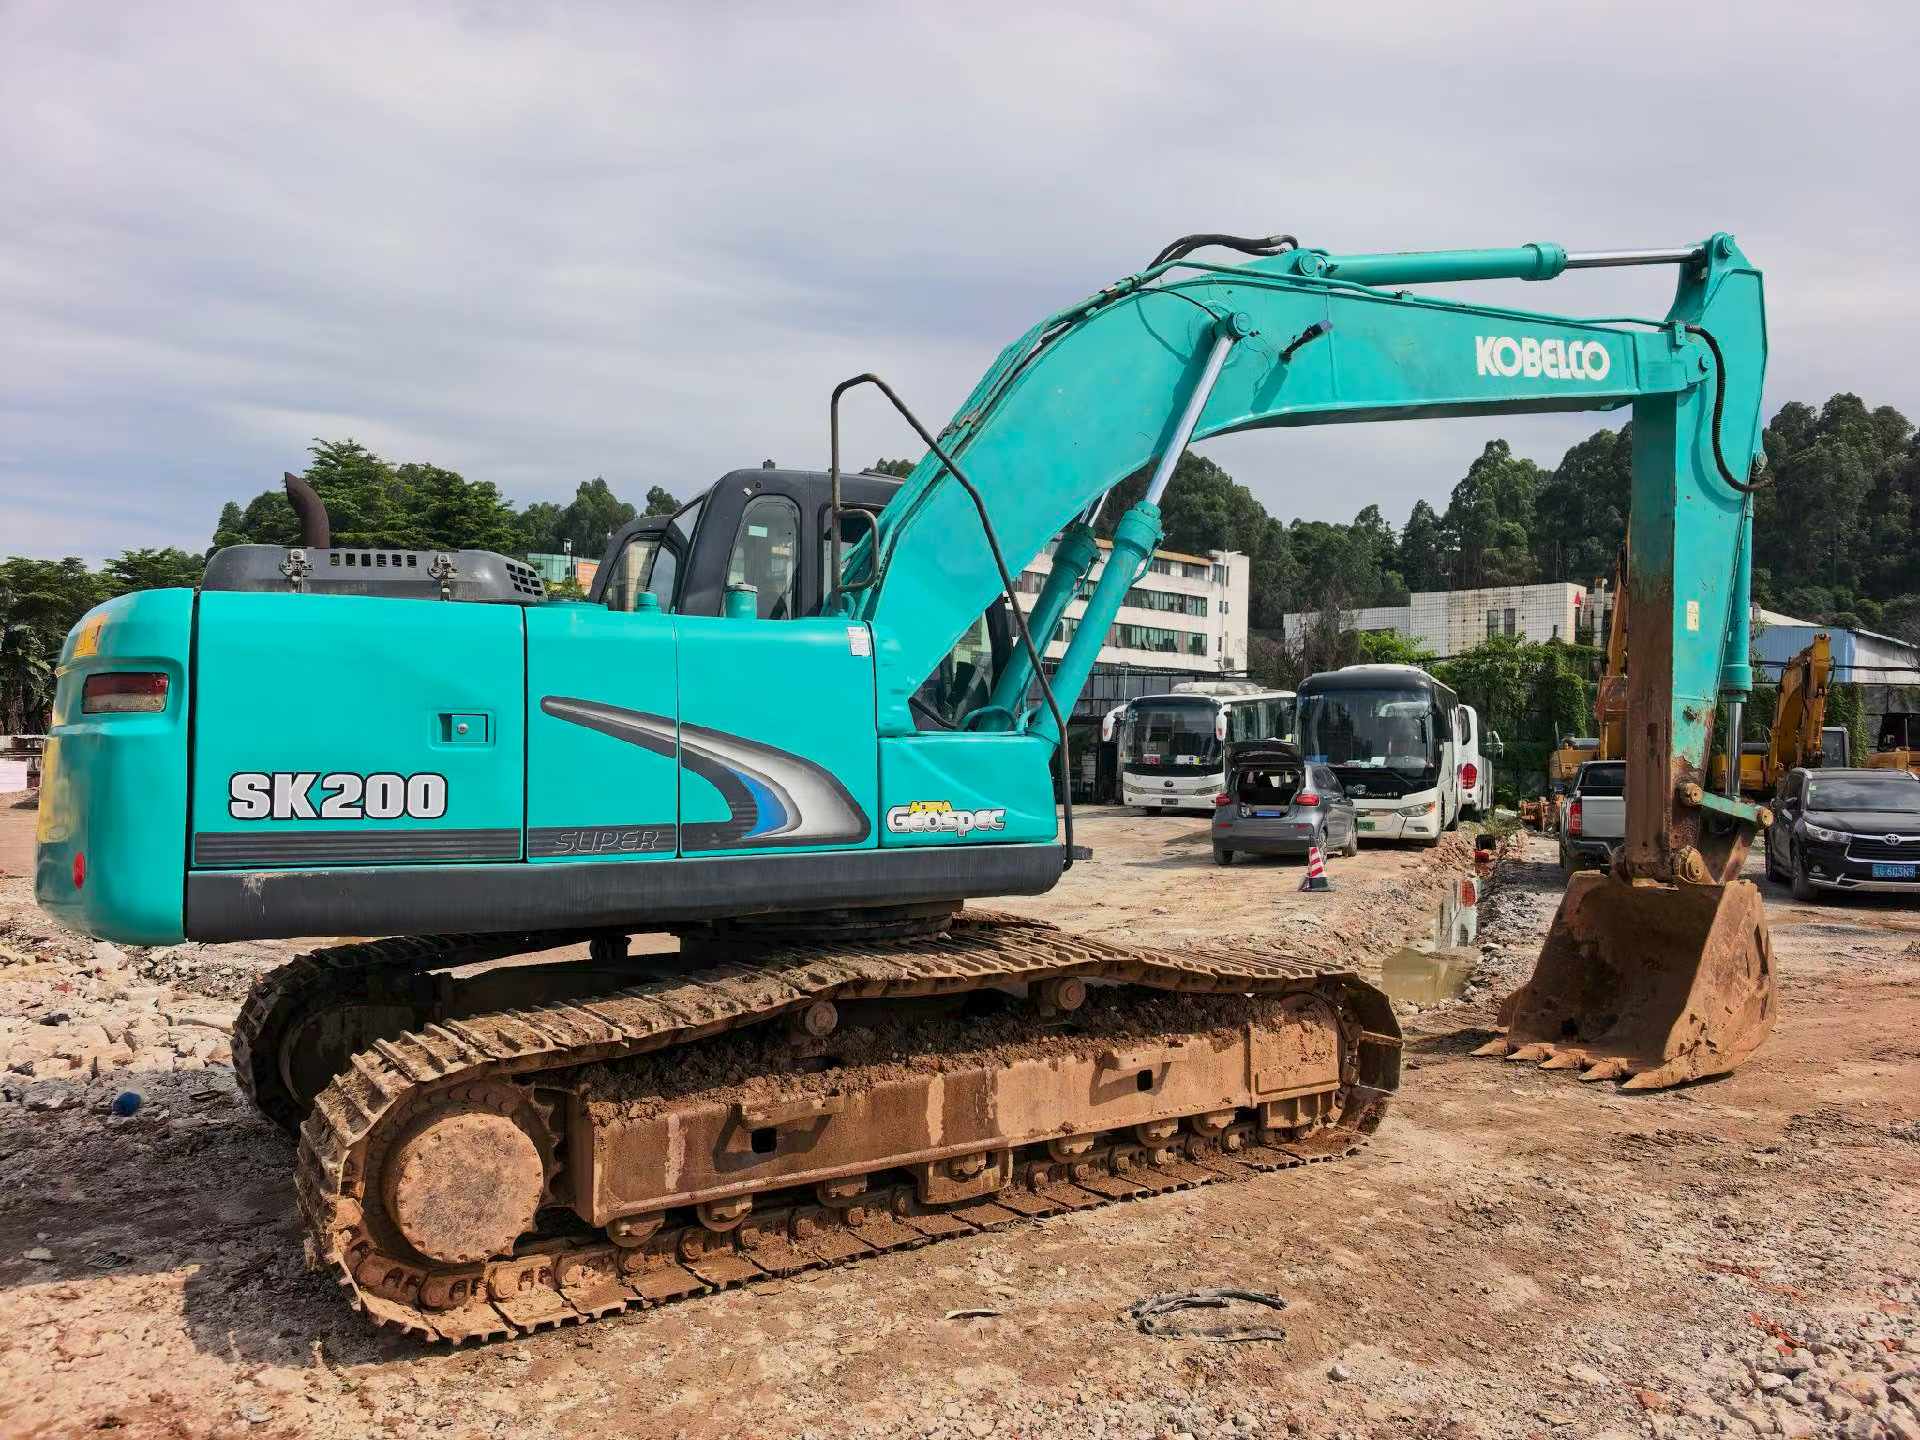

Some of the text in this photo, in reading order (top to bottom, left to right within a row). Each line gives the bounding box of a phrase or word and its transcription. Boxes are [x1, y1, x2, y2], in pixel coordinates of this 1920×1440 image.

[1475, 335, 1610, 381] KOBELCO
[229, 772, 447, 820] SK200
[555, 831, 660, 853] SUPER
